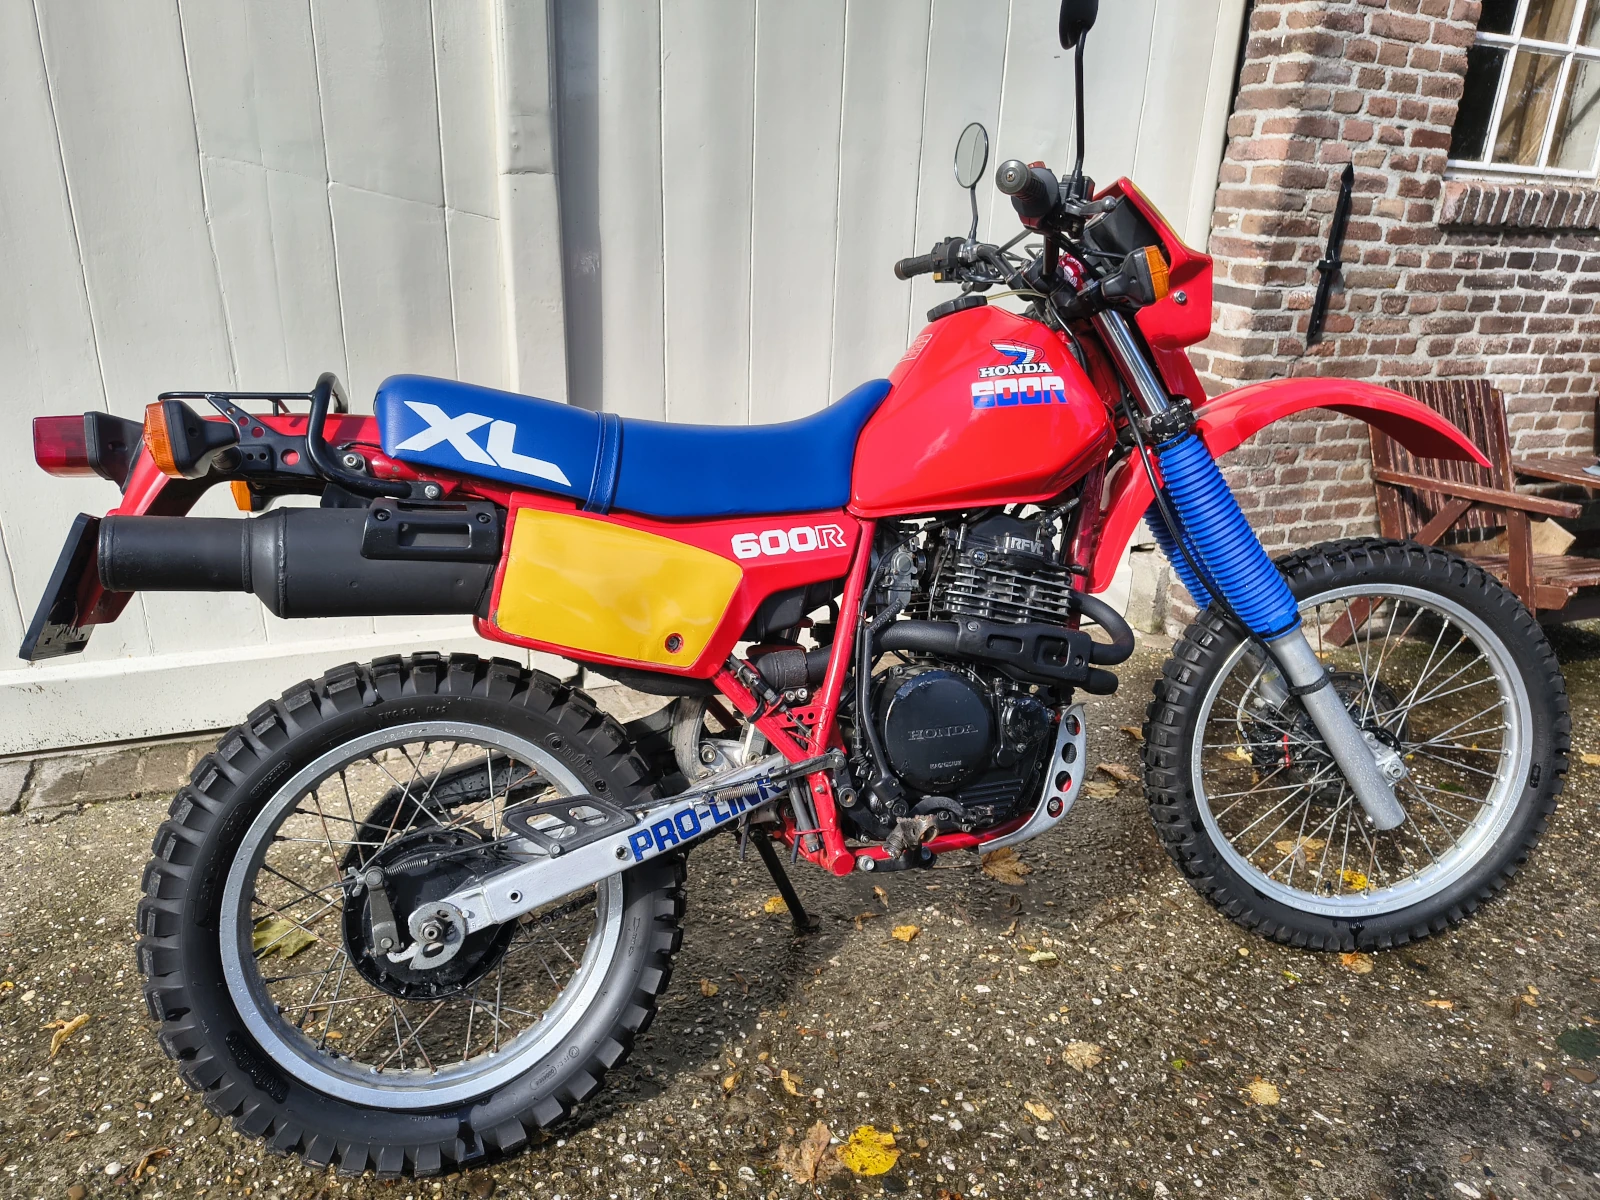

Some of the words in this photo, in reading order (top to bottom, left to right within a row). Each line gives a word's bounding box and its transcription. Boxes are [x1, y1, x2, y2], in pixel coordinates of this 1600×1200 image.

[979, 362, 1053, 379] HONDA
[970, 376, 1068, 409] 600R
[395, 400, 572, 487] XL
[731, 524, 847, 560] 600R
[1010, 536, 1045, 556] RFVC
[907, 723, 979, 741] HONDA
